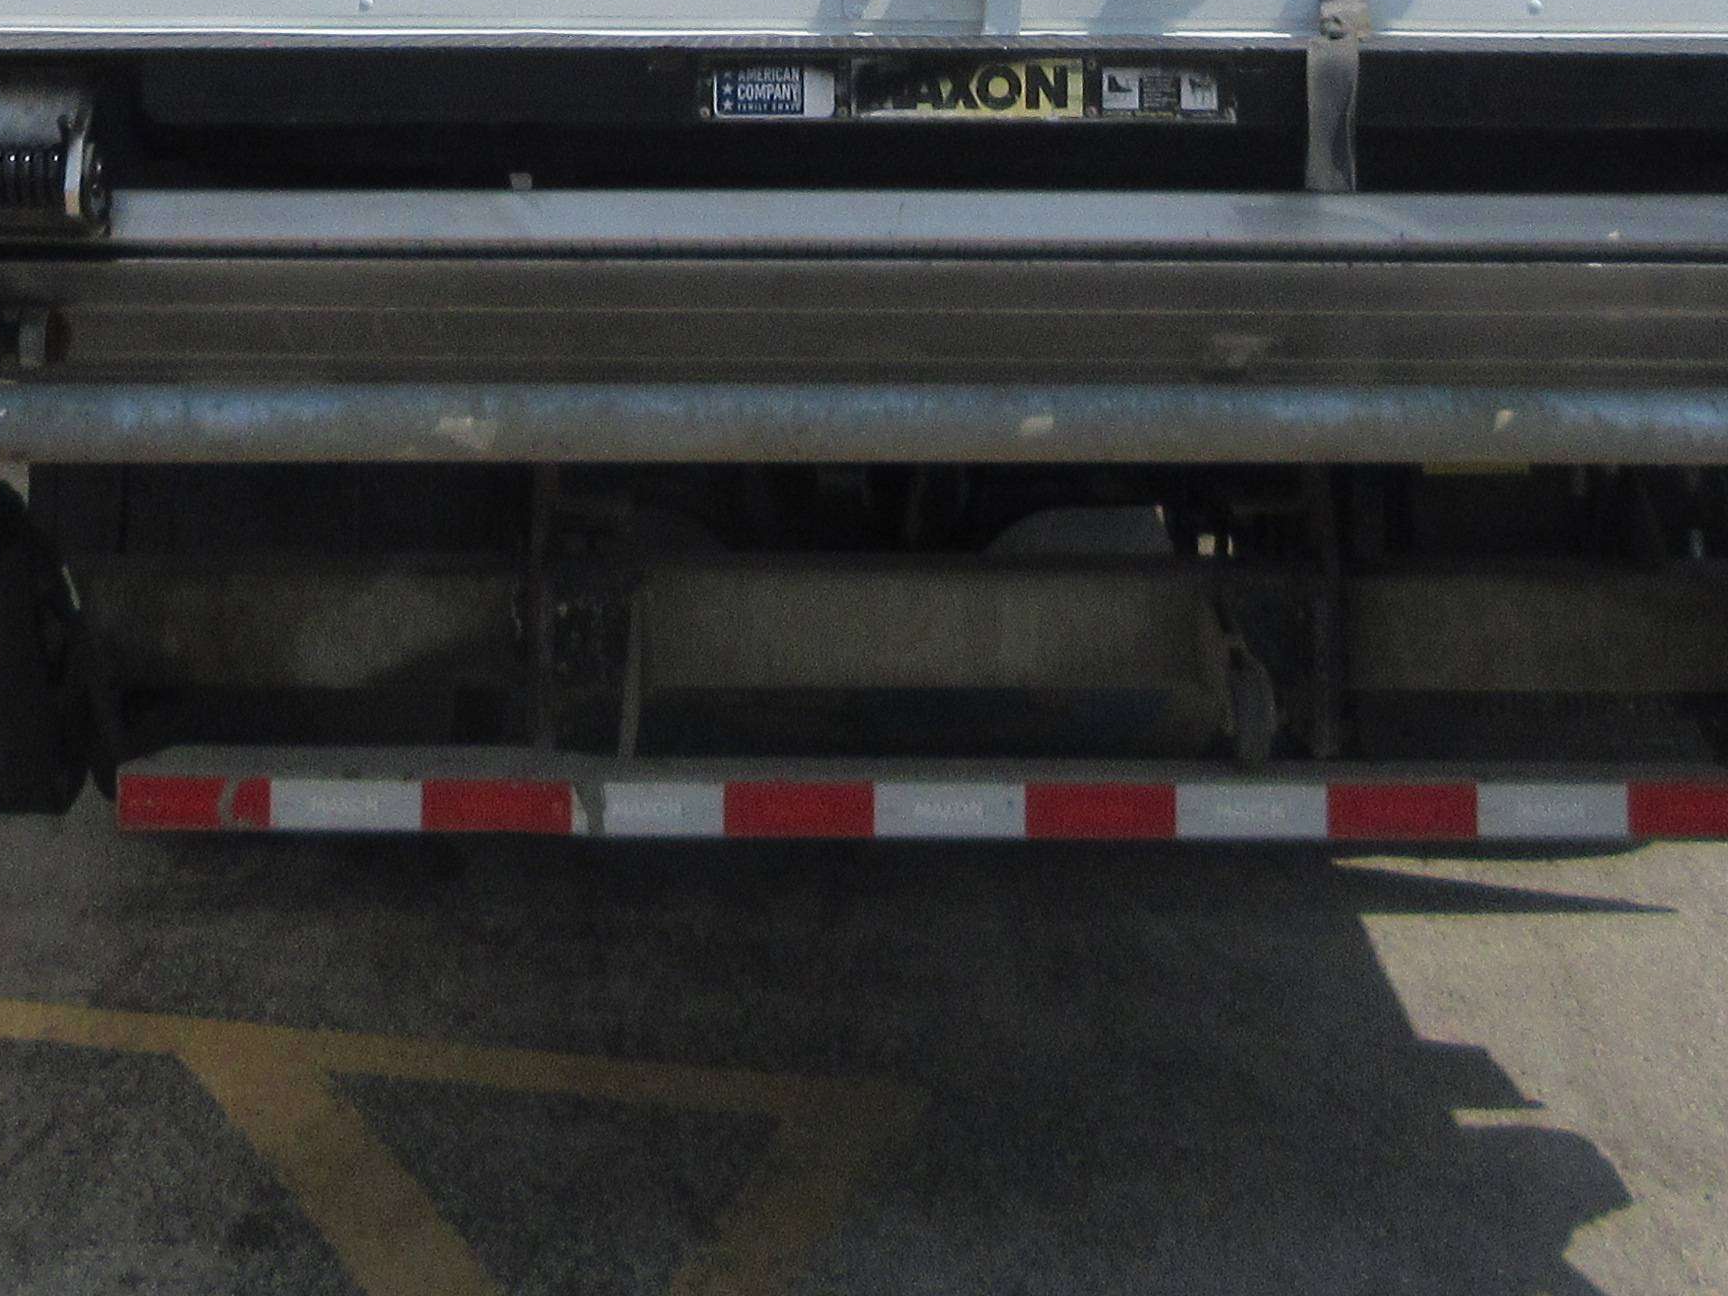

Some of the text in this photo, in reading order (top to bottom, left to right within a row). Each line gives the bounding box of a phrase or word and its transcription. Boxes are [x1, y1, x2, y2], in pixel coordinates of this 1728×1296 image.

[737, 67, 801, 82] AMERICAN
[737, 83, 801, 102] COMPANY
[862, 63, 1069, 110] AXON
